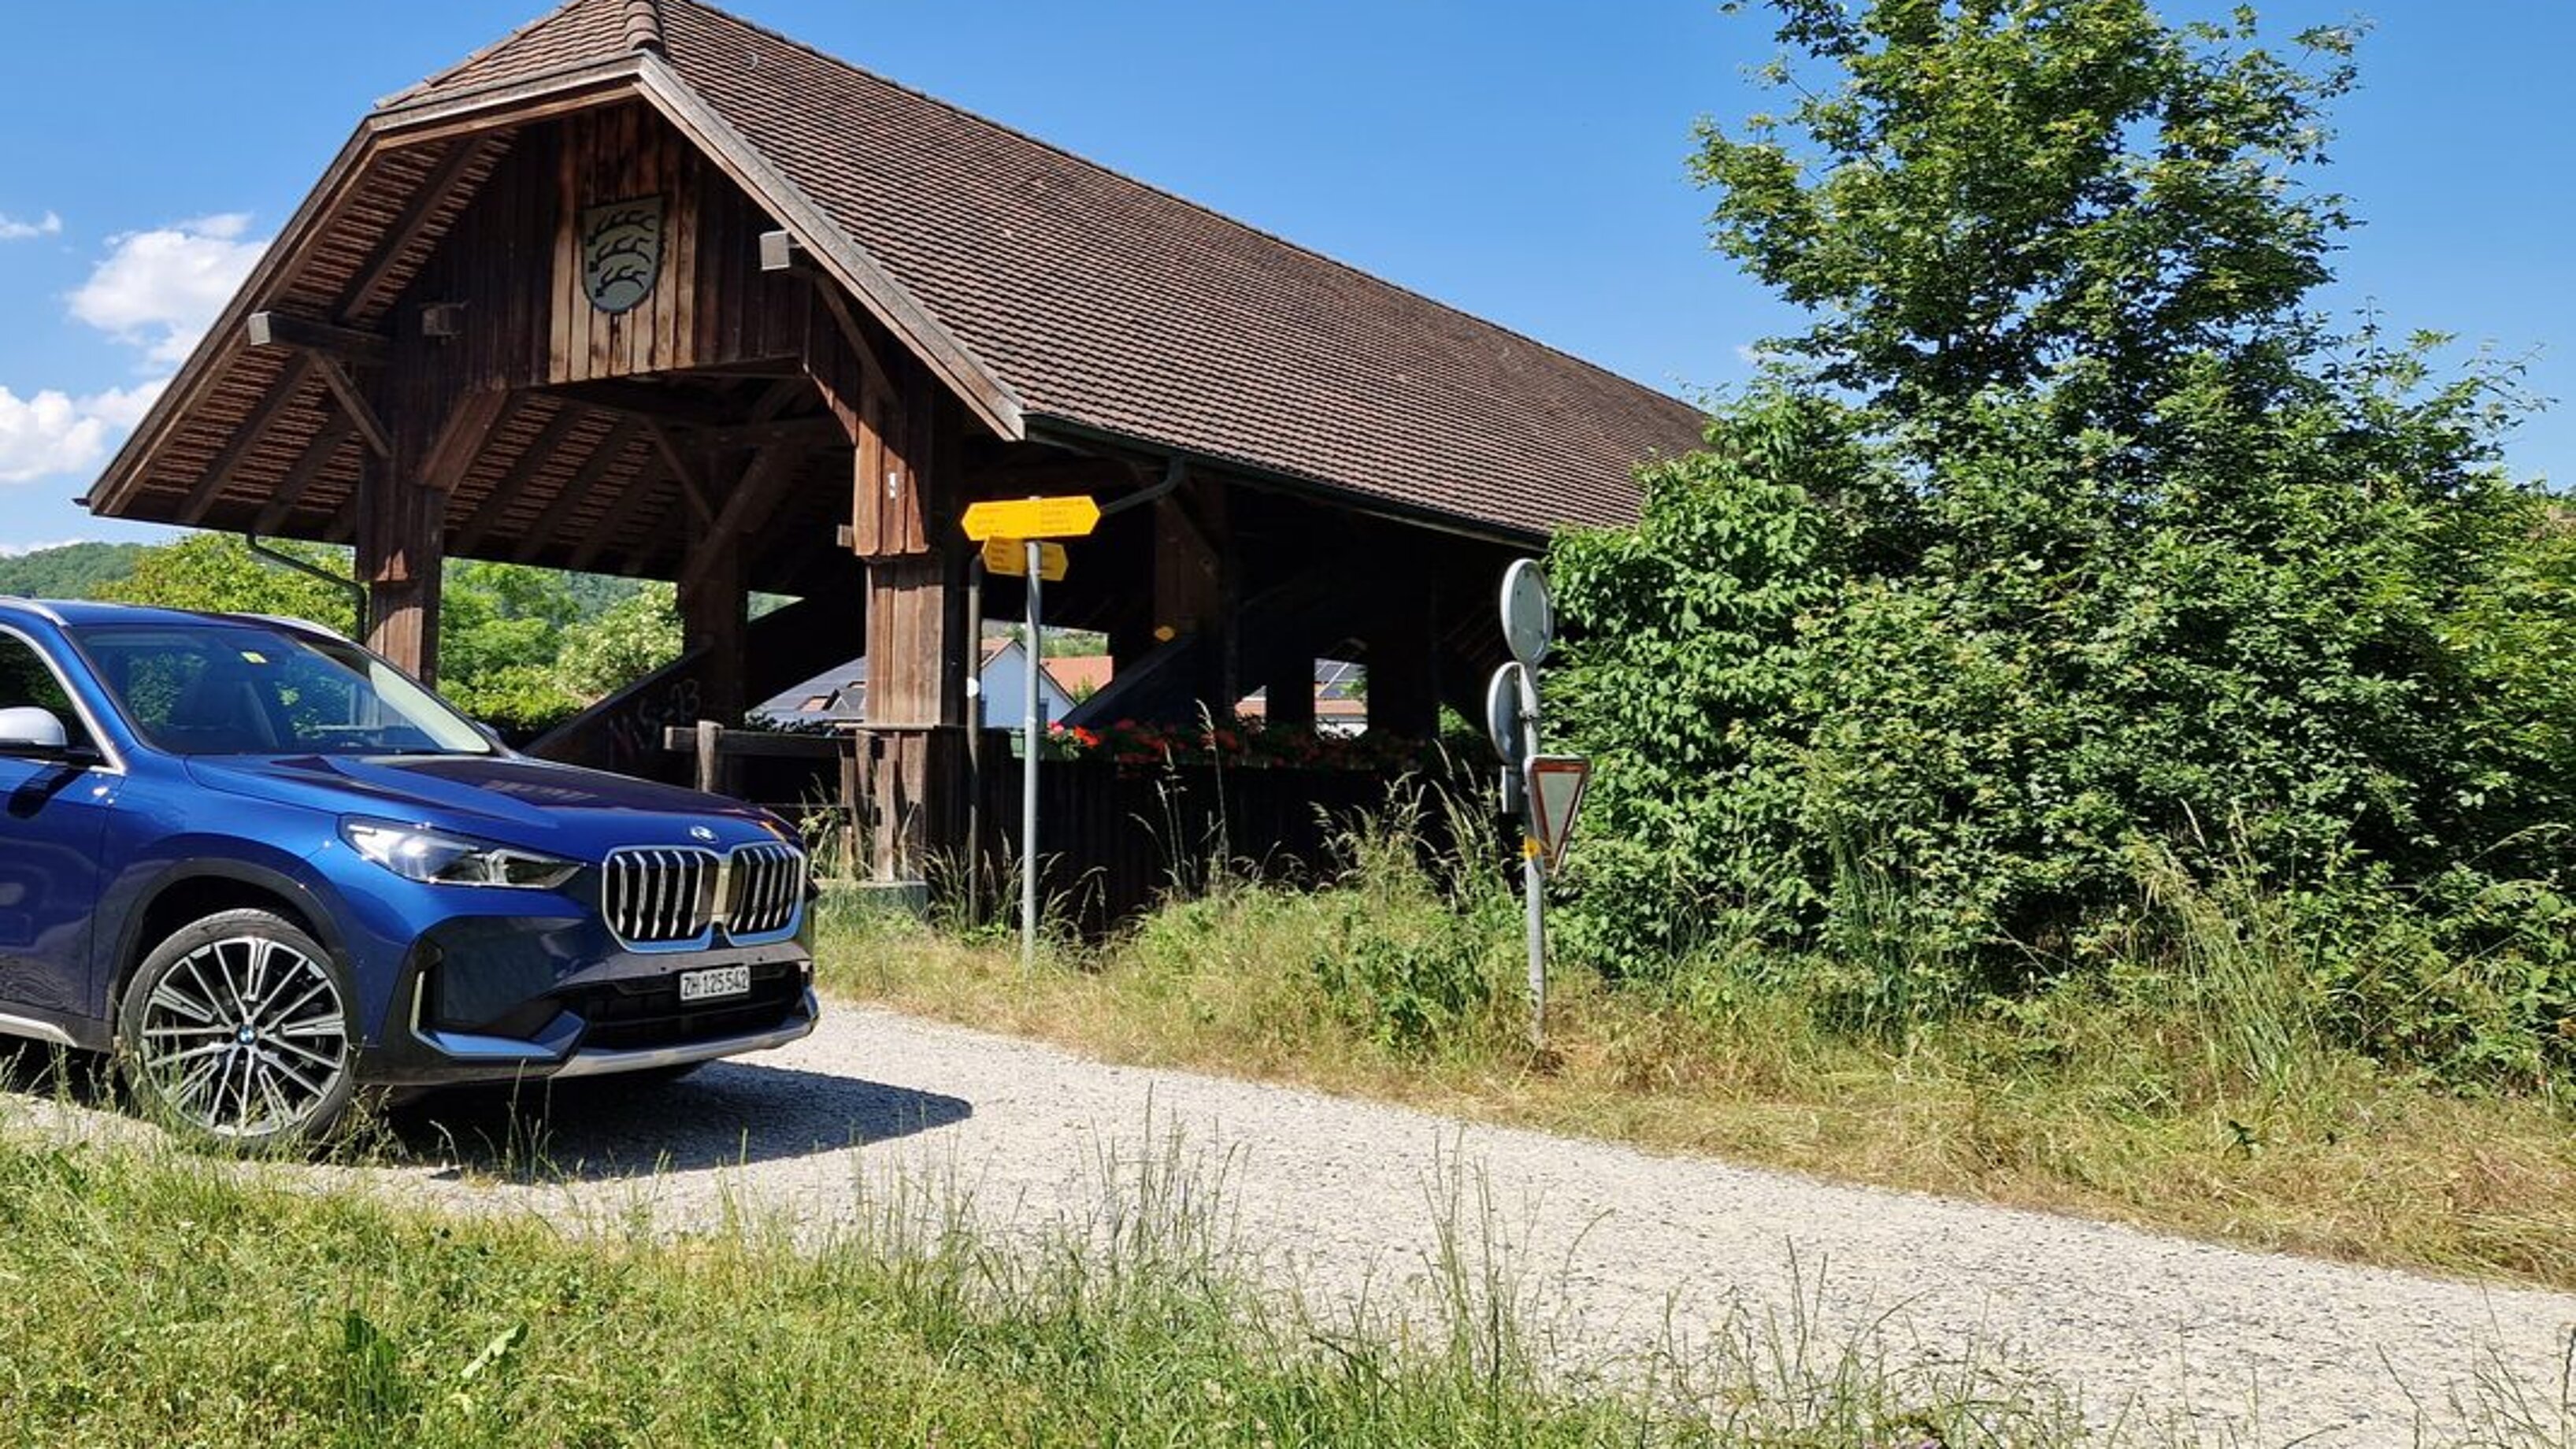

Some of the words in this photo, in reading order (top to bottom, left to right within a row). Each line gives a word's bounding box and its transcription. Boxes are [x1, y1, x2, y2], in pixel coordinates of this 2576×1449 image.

[684, 976, 701, 997] ZH
[703, 973, 725, 994] 125
[726, 968, 747, 991] 542
